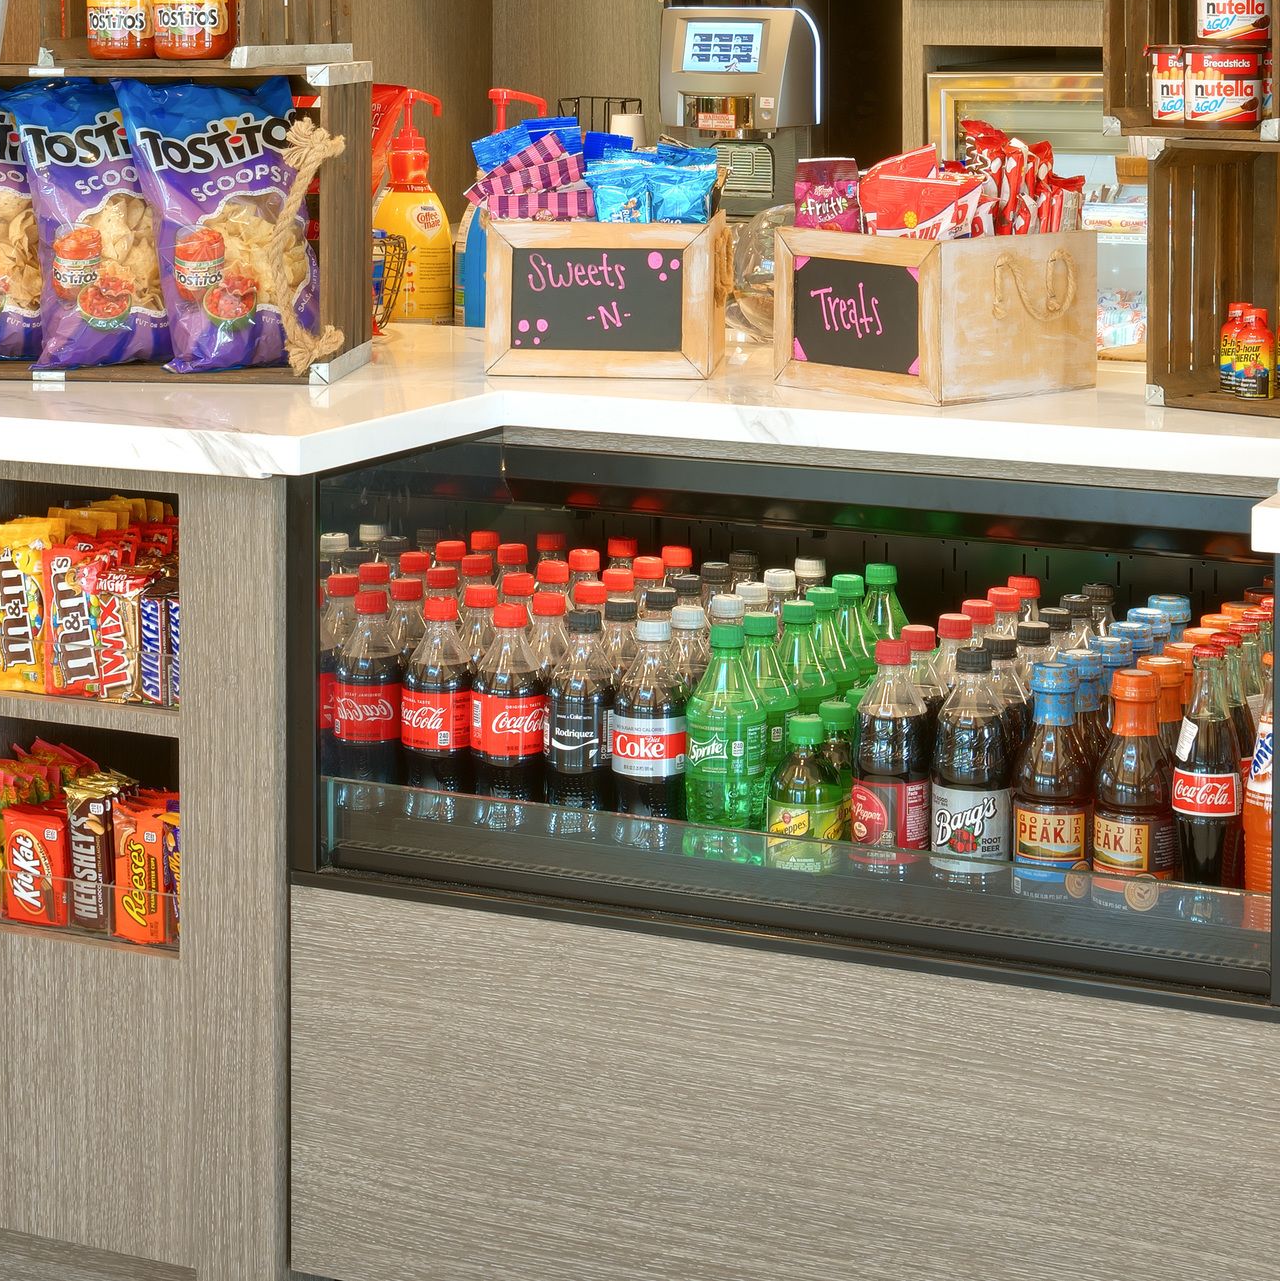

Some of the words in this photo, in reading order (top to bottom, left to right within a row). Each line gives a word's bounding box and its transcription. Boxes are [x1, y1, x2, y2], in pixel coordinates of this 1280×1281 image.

[1206, 14, 1236, 30] &GO!
[1204, 58, 1251, 68] Breadsticks
[1195, 80, 1254, 97] nutella
[1195, 97, 1225, 112] &GO!
[140, 111, 297, 169] TOSTITO
[191, 164, 291, 202] SCOOPS!
[417, 211, 440, 224] Coffee
[424, 220, 441, 230] mate
[528, 253, 626, 292] Sweets
[810, 282, 884, 339] Treats
[1235, 341, 1262, 354] 5-hour
[1235, 352, 1261, 363] ENERGY
[100, 597, 129, 698] TWIX
[141, 599, 161, 699] SNICKERS
[615, 734, 666, 758] Coke
[646, 735, 661, 743] Diet
[691, 741, 724, 761] Sprite
[1174, 778, 1230, 806] Coca-Cola
[854, 803, 882, 821] Pepper
[1020, 813, 1067, 826] GOLD
[935, 796, 998, 848] Barq's
[981, 836, 1002, 845] ROOT
[981, 845, 1001, 853] BEER
[70, 815, 99, 919] HERSHEY'S
[122, 839, 148, 927] Reese's
